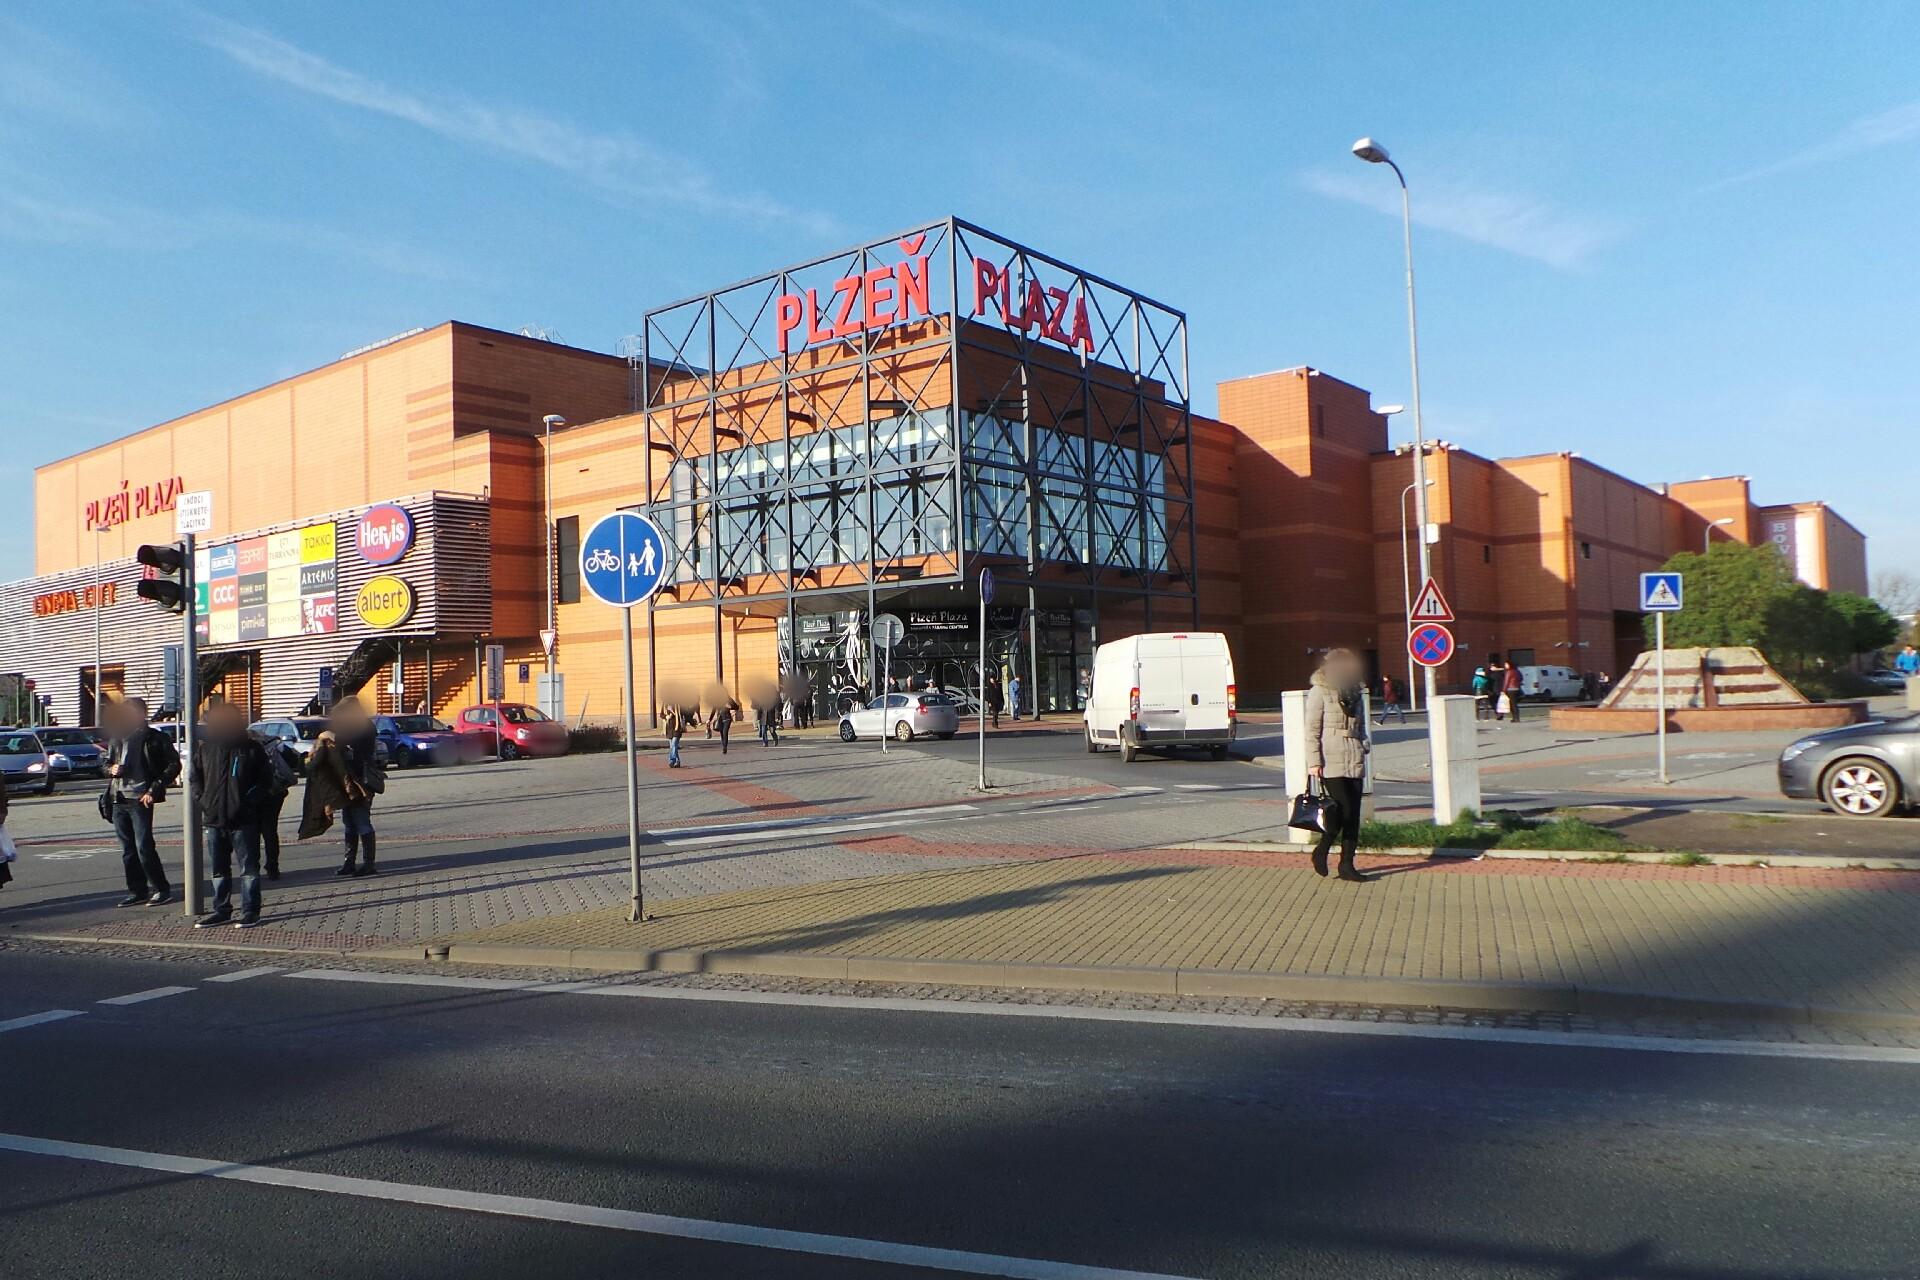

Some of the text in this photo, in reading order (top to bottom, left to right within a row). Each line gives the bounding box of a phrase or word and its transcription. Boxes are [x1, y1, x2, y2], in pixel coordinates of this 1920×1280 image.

[777, 234, 1096, 353] PLZEŇ PLAZA
[85, 480, 130, 531] PLZEŇ
[360, 518, 406, 550] Hervis
[302, 568, 335, 585] ARTEMIS
[83, 582, 116, 608] CITY
[213, 584, 236, 604] CCC
[361, 588, 403, 612] albert
[315, 603, 336, 618] KFC
[910, 611, 968, 623] Plzeň Plaza
